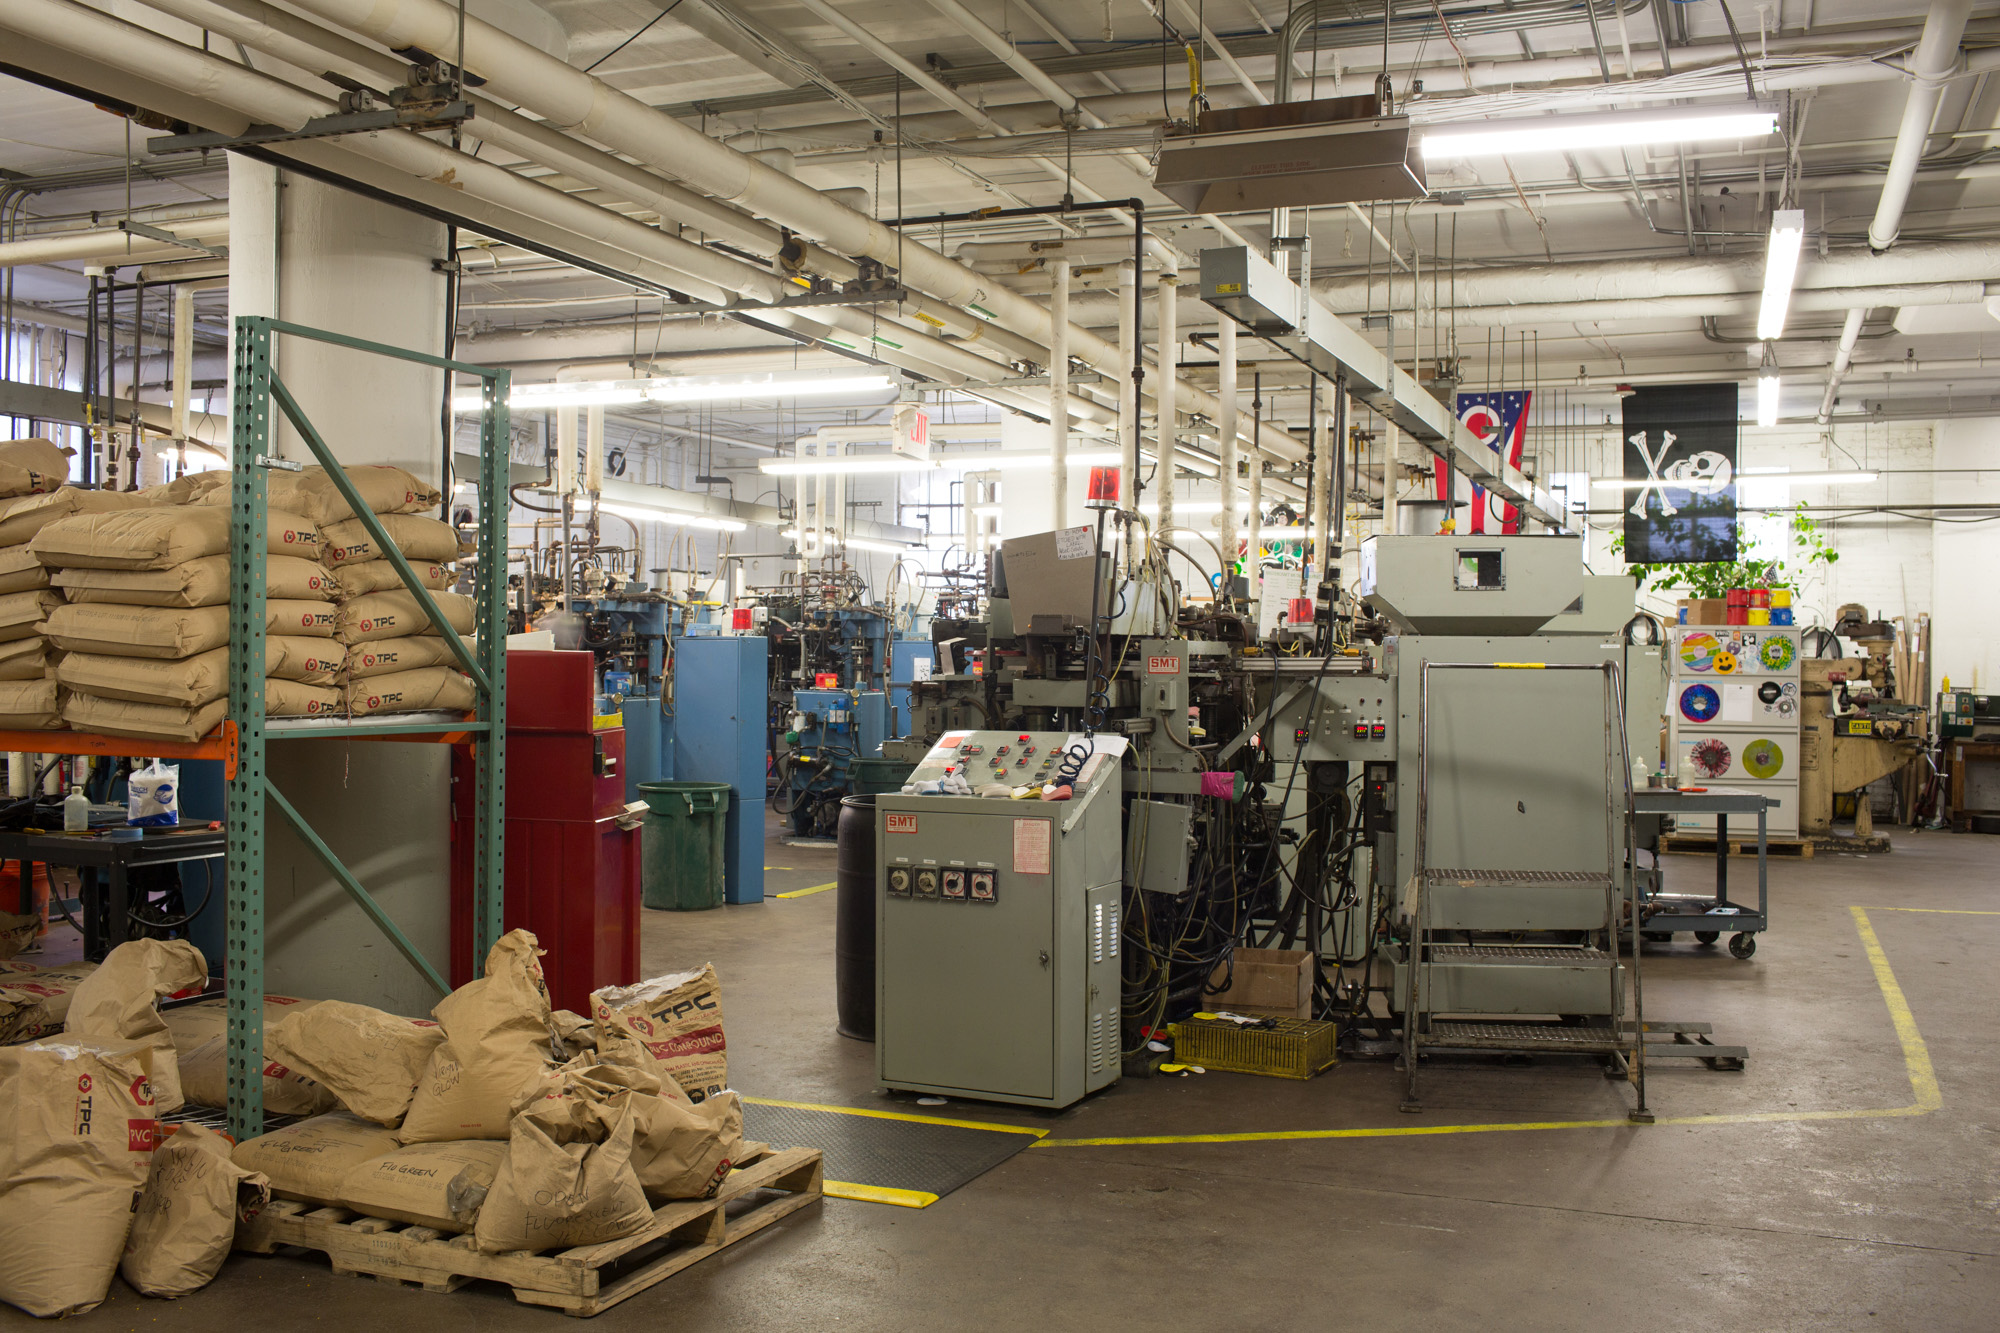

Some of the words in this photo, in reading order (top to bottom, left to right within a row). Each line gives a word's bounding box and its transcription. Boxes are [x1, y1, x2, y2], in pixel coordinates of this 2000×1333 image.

[297, 532, 317, 543] TPC
[346, 543, 369, 557] TPC
[315, 614, 334, 624] TPC
[373, 616, 395, 628] TPC
[377, 653, 398, 663] TPC
[1151, 658, 1176, 668] SMT
[318, 660, 338, 672] TPC
[381, 693, 403, 704] TPC
[889, 816, 914, 827] SMT
[651, 991, 717, 1024] TPC
[669, 1033, 723, 1053] COMPOUND
[432, 1072, 460, 1097] GLOW
[78, 1096, 92, 1135] TPC
[130, 1129, 151, 1142] PVC
[398, 1164, 440, 1178] GREEN
[534, 1186, 589, 1207] OPEN
